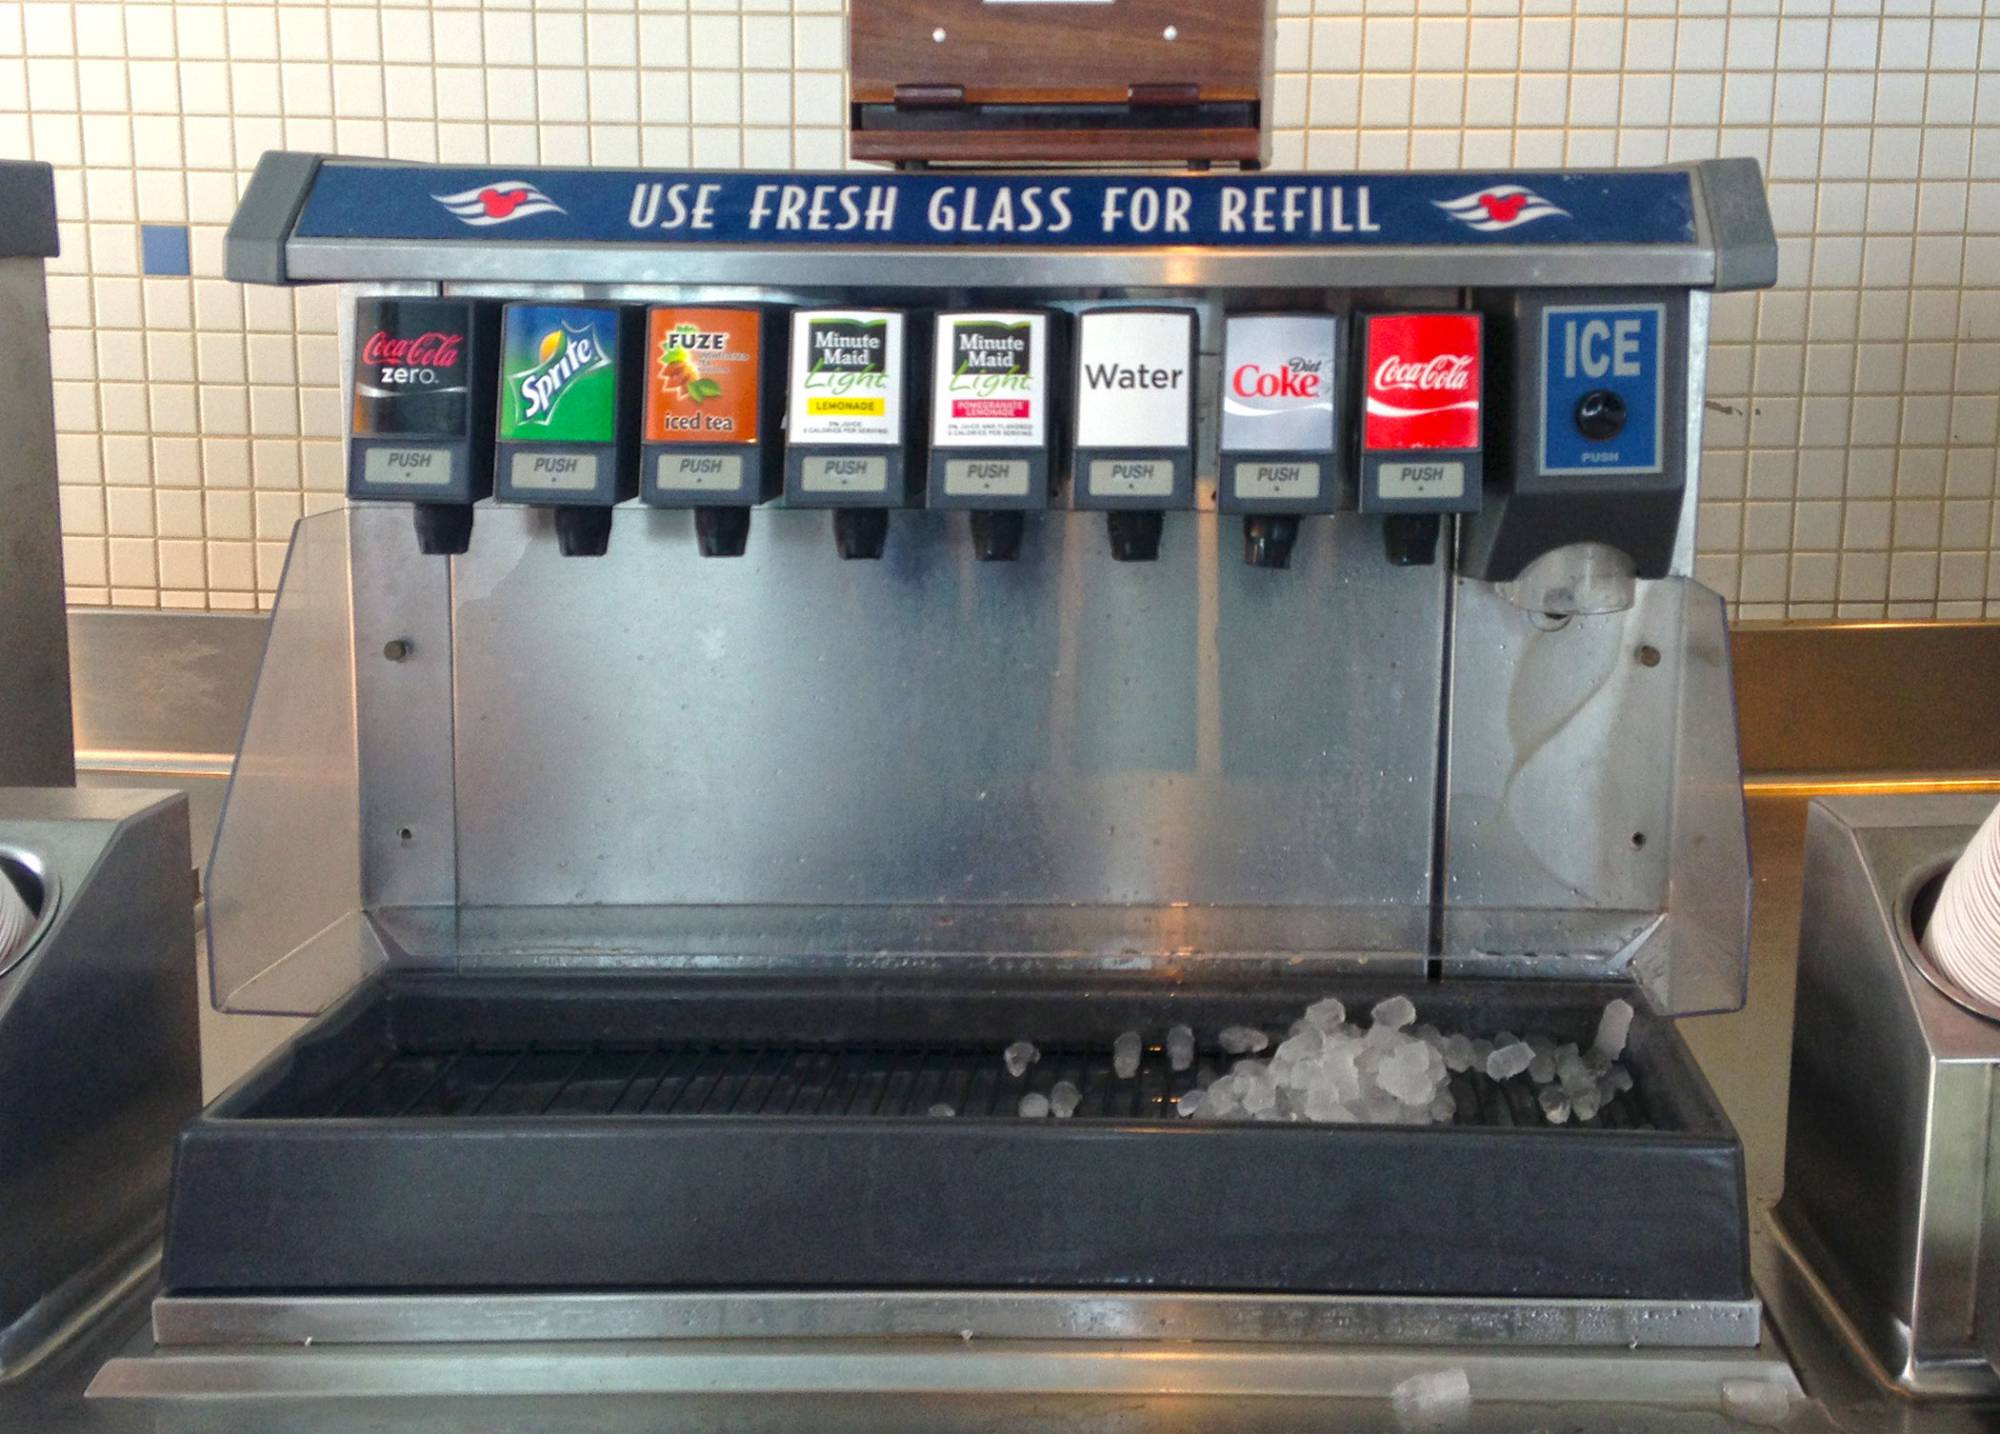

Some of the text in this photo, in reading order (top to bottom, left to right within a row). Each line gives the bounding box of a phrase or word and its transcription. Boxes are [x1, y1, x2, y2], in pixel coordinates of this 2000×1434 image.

[629, 183, 1379, 233] USE FRESH GLASS FOR REFILL
[669, 334, 723, 350] FUZE
[815, 331, 880, 349] Minute
[959, 333, 1024, 350] Minute
[1565, 319, 1641, 378] ICE
[362, 331, 463, 367] Coca-Cola
[824, 348, 869, 365] Maid
[968, 350, 1015, 367] Maid
[1288, 356, 1322, 372] Diet
[381, 367, 434, 384] zero
[521, 336, 592, 418] Sprite
[804, 357, 888, 395] Light
[949, 359, 1033, 397] Light
[1085, 364, 1183, 390] Water
[1232, 364, 1320, 398] Coke
[1374, 354, 1474, 391] Coca-Cola
[816, 401, 874, 411] LEMONADE
[665, 412, 733, 430] iced tea
[388, 452, 432, 468] PUSH
[534, 457, 577, 473] PUSH
[679, 459, 722, 473] PUSH
[1581, 452, 1620, 463] PUSH
[824, 461, 867, 475] PUSH
[967, 464, 1010, 478] PUSH
[1111, 464, 1154, 479] PUSH
[1256, 466, 1300, 481] PUSH
[1400, 466, 1444, 482] PUSH
